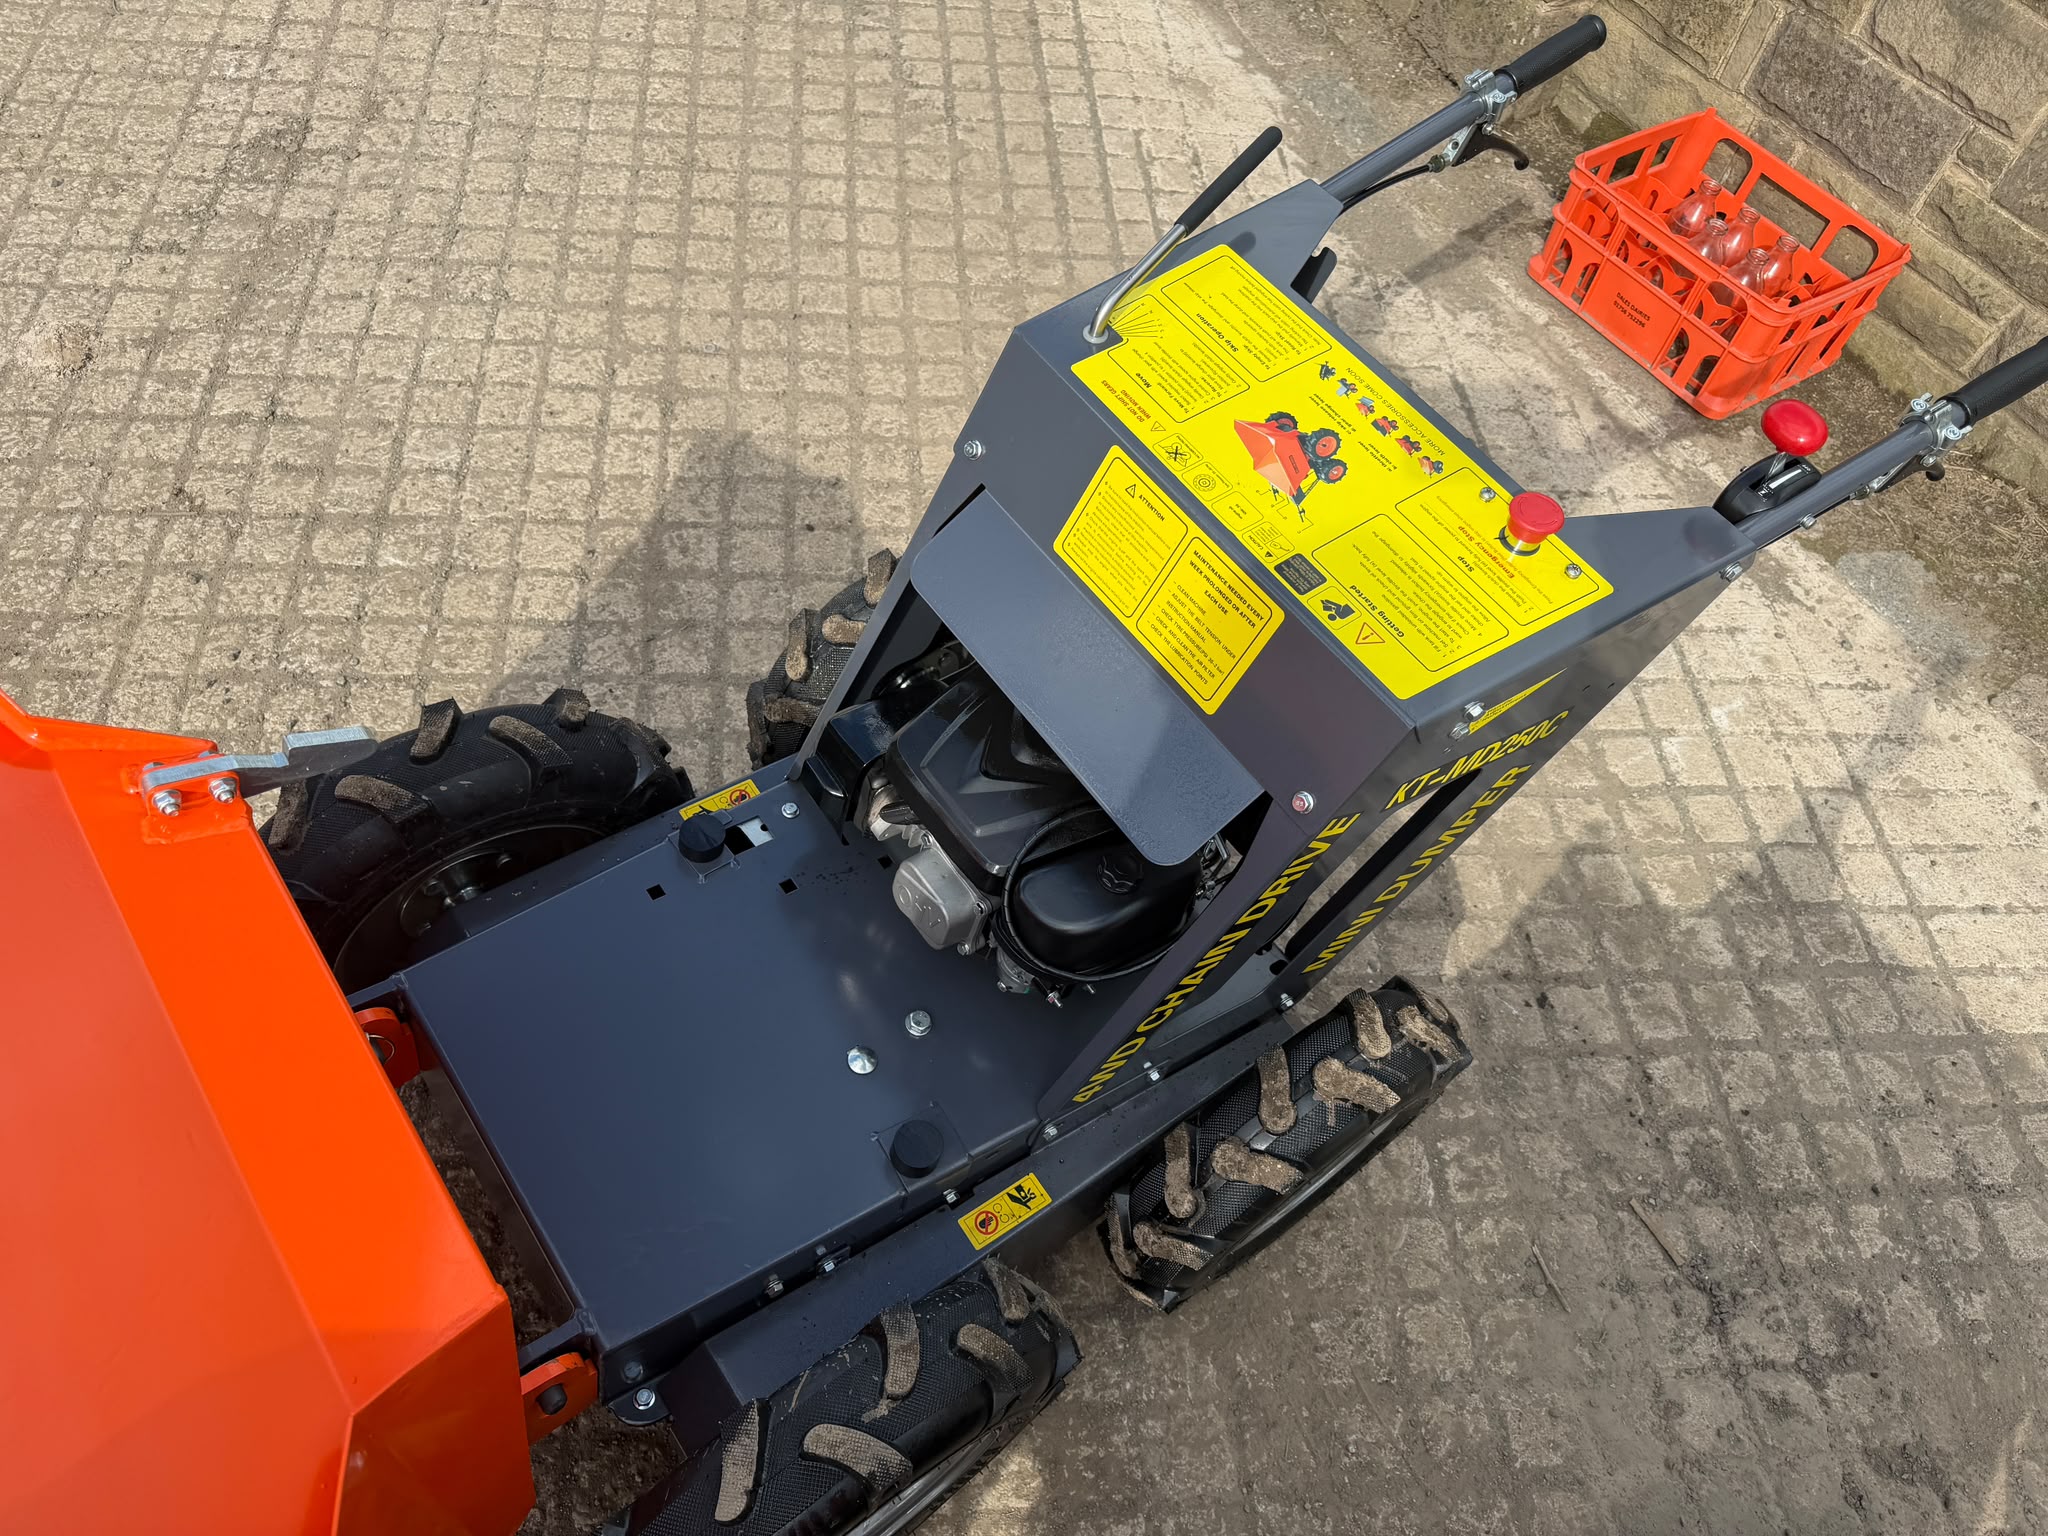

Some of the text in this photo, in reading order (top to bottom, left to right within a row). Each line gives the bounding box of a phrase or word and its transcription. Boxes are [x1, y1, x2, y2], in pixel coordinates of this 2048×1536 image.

[1613, 300, 1627, 315] 01756
[1617, 292, 1650, 321] DALES DAIRIES
[1195, 312, 1225, 339] Operation
[1224, 339, 1239, 352] Skip
[1100, 379, 1116, 394] GEARS
[1134, 372, 1152, 388] Move
[1114, 393, 1129, 406] SHIFT
[1120, 389, 1151, 419] WHEN MOVING
[1127, 406, 1138, 416] NOT
[1345, 367, 1445, 456] MORE ACCESSORIES COME SOON
[1138, 493, 1165, 521] ATTENTION
[1456, 555, 1475, 572] Stop
[1457, 525, 1515, 578] Emergency Stop
[1176, 584, 1206, 616] CLEAN MACHINE
[1189, 559, 1256, 628] WEEK PROLONGED OR AFTER
[1193, 549, 1264, 621] MAINTENANCE NEEDED EVERY
[1204, 589, 1228, 615] EACH USE
[1348, 584, 1405, 637] Getting Started
[1160, 608, 1173, 622] CHECK
[1173, 620, 1184, 632] TYRE
[1165, 599, 1206, 643] INSTRUCTION MANUAL
[1171, 592, 1236, 659] ADJUST THE BELT TENSION UNDER
[1150, 623, 1208, 684] CHECK THE LUBRICATION POINTS
[1155, 615, 1215, 678] CHECK AND CLEAN THE AIR FILTER
[1385, 711, 1569, 810] KT-MD250C
[1303, 764, 1532, 973] MINI DUMPER
[1073, 812, 1364, 1102] 4WD CHAIN DRIVE
